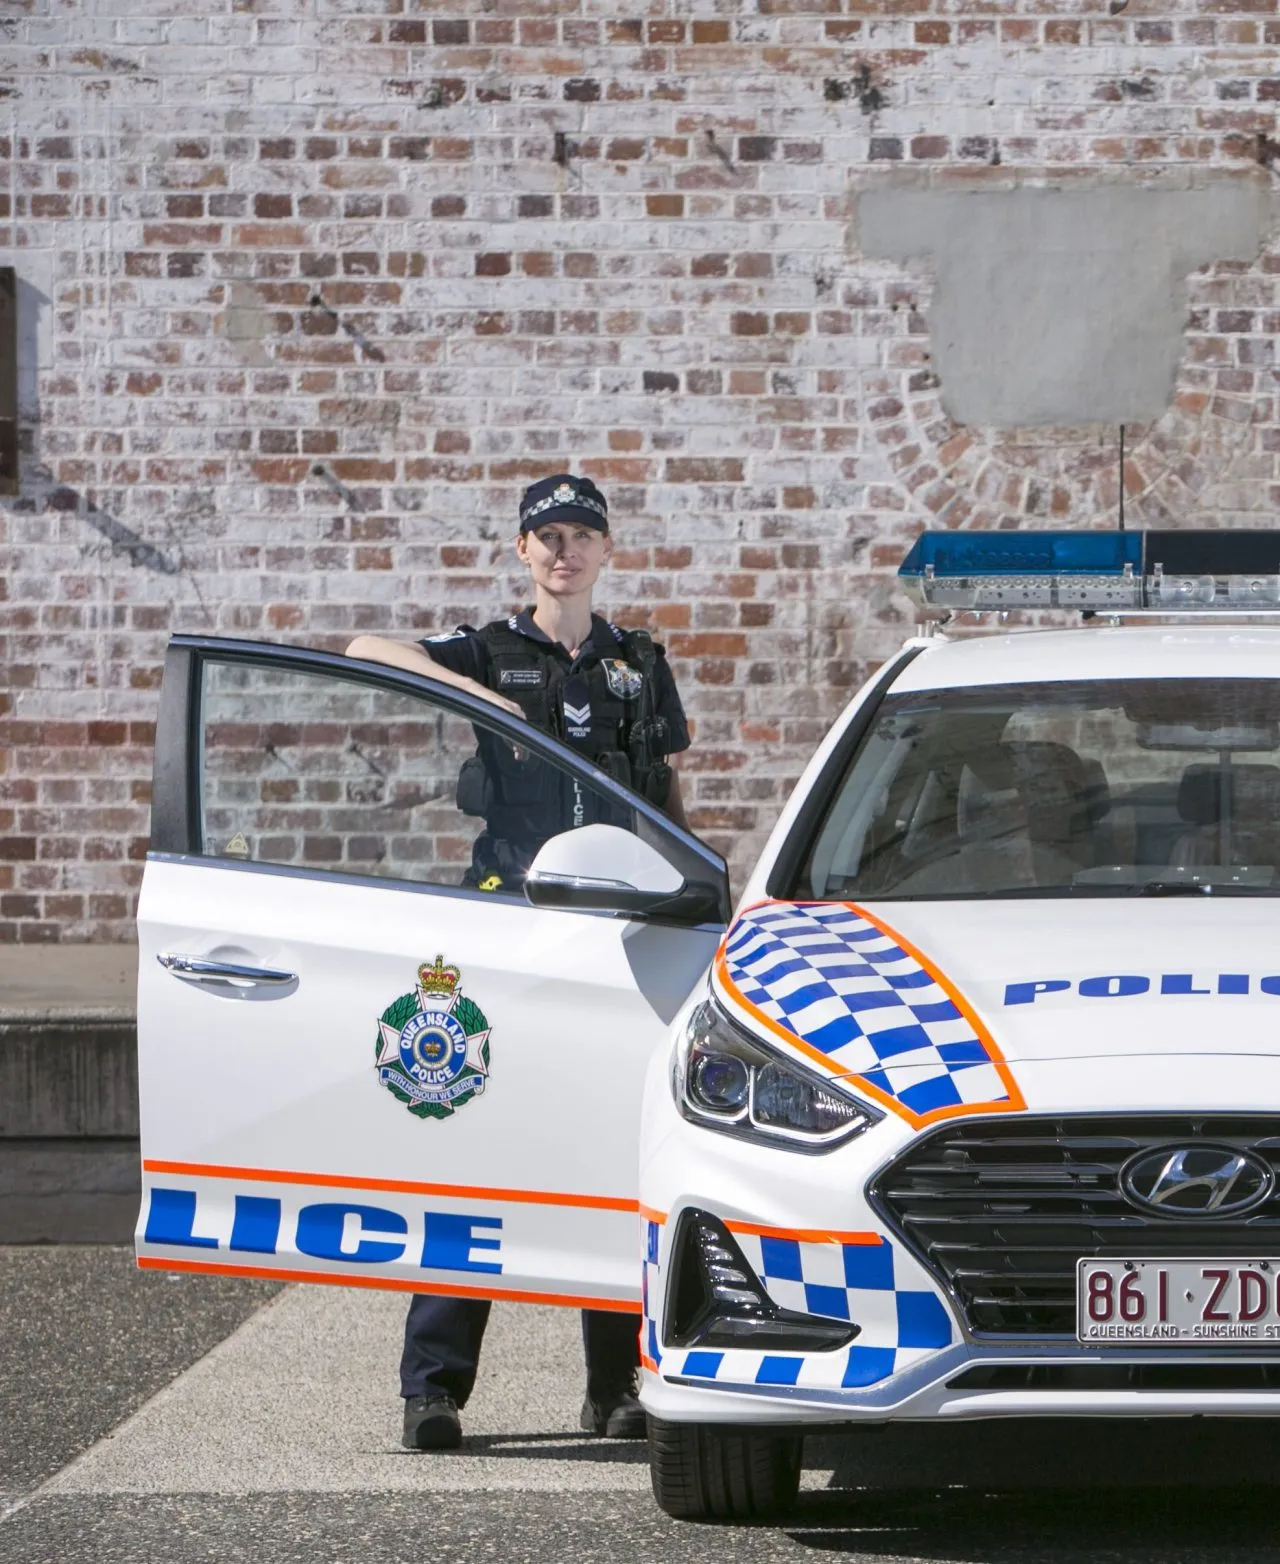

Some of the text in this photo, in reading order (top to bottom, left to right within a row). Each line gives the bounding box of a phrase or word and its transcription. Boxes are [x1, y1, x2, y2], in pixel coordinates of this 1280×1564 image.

[573, 777, 584, 826] LICE
[401, 1013, 466, 1053] QUEENSLAND
[388, 1071, 475, 1100] WITH HONOUR WE SERVE
[410, 1064, 454, 1083] POLICE
[145, 1187, 503, 1275] LICE
[1089, 1325, 1178, 1338] QUEENSLAND
[1193, 1325, 1258, 1338] SUNSHINE
